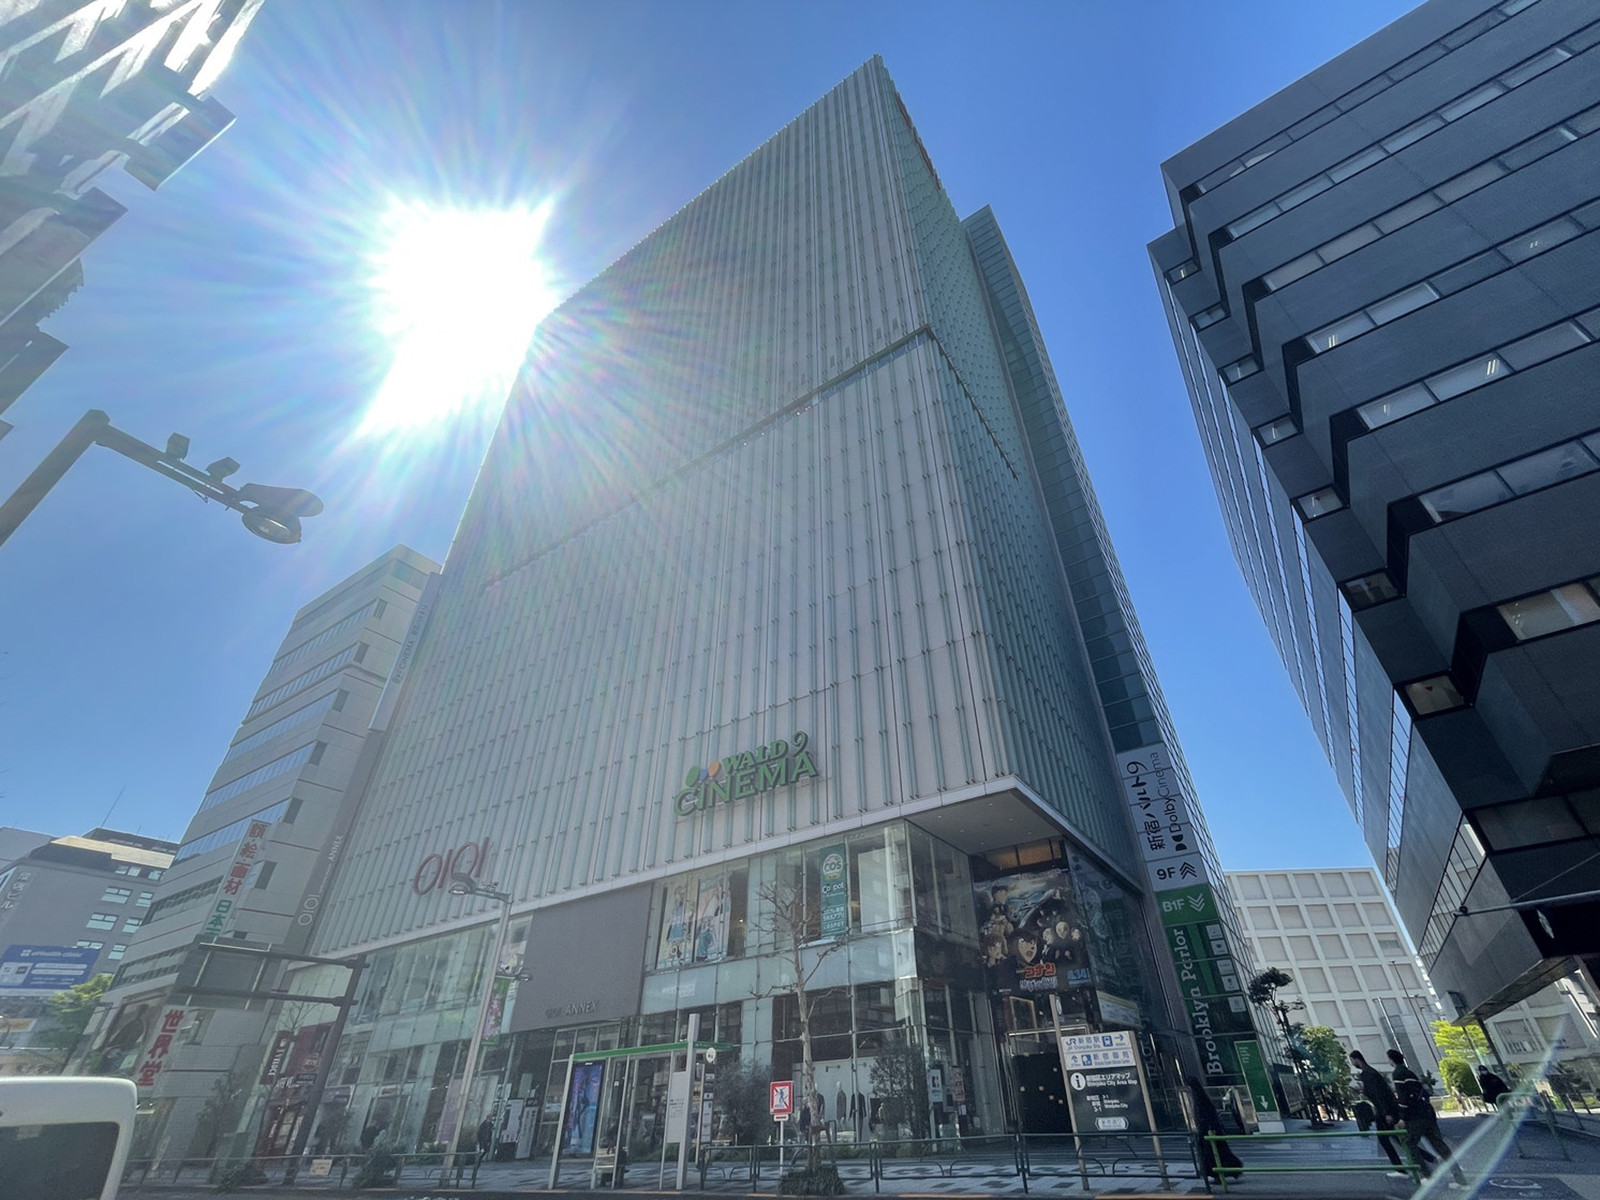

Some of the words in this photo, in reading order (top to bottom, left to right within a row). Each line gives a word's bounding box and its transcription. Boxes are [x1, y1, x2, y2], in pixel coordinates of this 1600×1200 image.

[721, 739, 789, 774] WALD
[791, 730, 809, 758] 9
[673, 751, 819, 816] CINEMA
[1126, 760, 1166, 851] 新宿バルト9
[1156, 866, 1176, 880] 9F
[1162, 898, 1185, 913] B1F
[1173, 928, 1198, 981] Parlor
[565, 1000, 598, 1016] ANNEX
[1191, 986, 1224, 1075] Brooklyn
[137, 1009, 186, 1086] 世界堂
